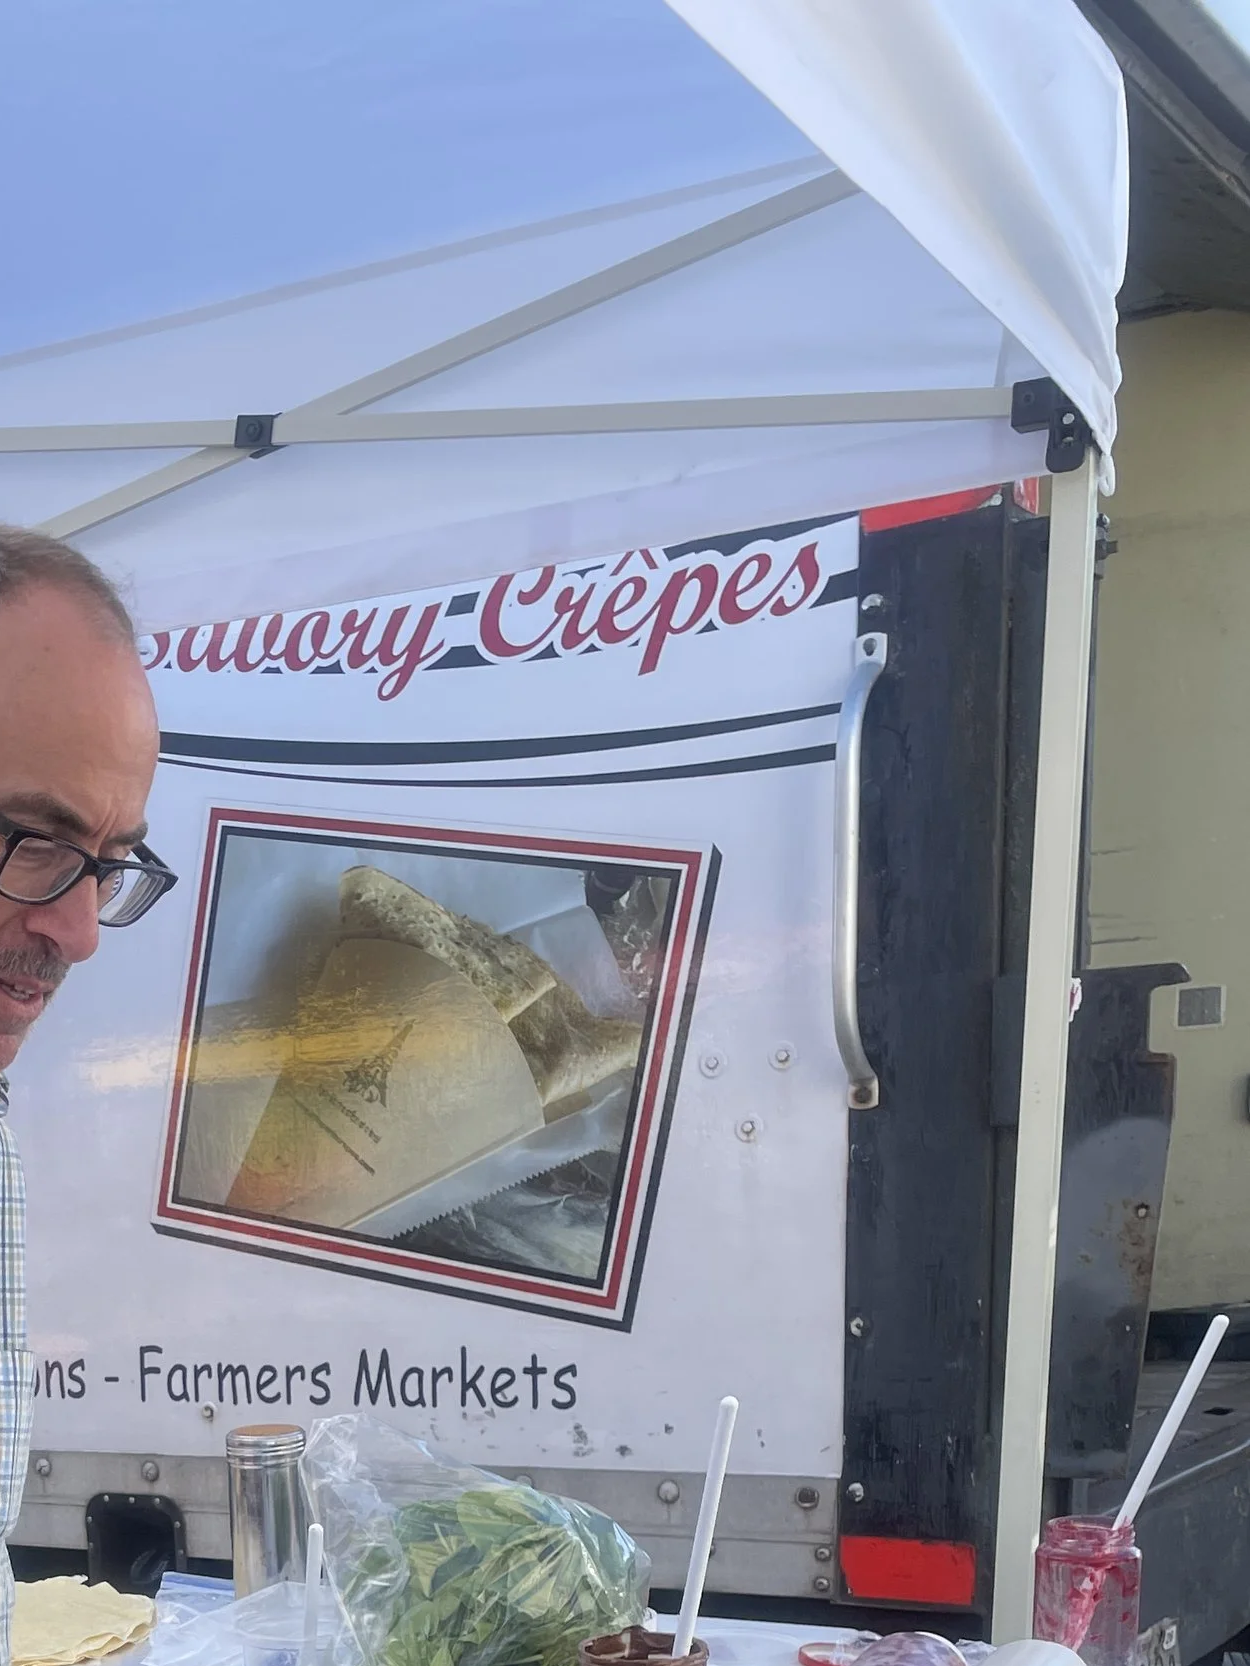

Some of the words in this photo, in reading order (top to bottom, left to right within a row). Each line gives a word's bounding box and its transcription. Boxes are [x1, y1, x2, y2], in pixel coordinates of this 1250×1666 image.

[144, 601, 445, 701] avory
[479, 541, 820, 676] Crêpes
[34, 1358, 86, 1399] ns
[138, 1345, 332, 1405] Farmers
[353, 1346, 578, 1410] Markets
